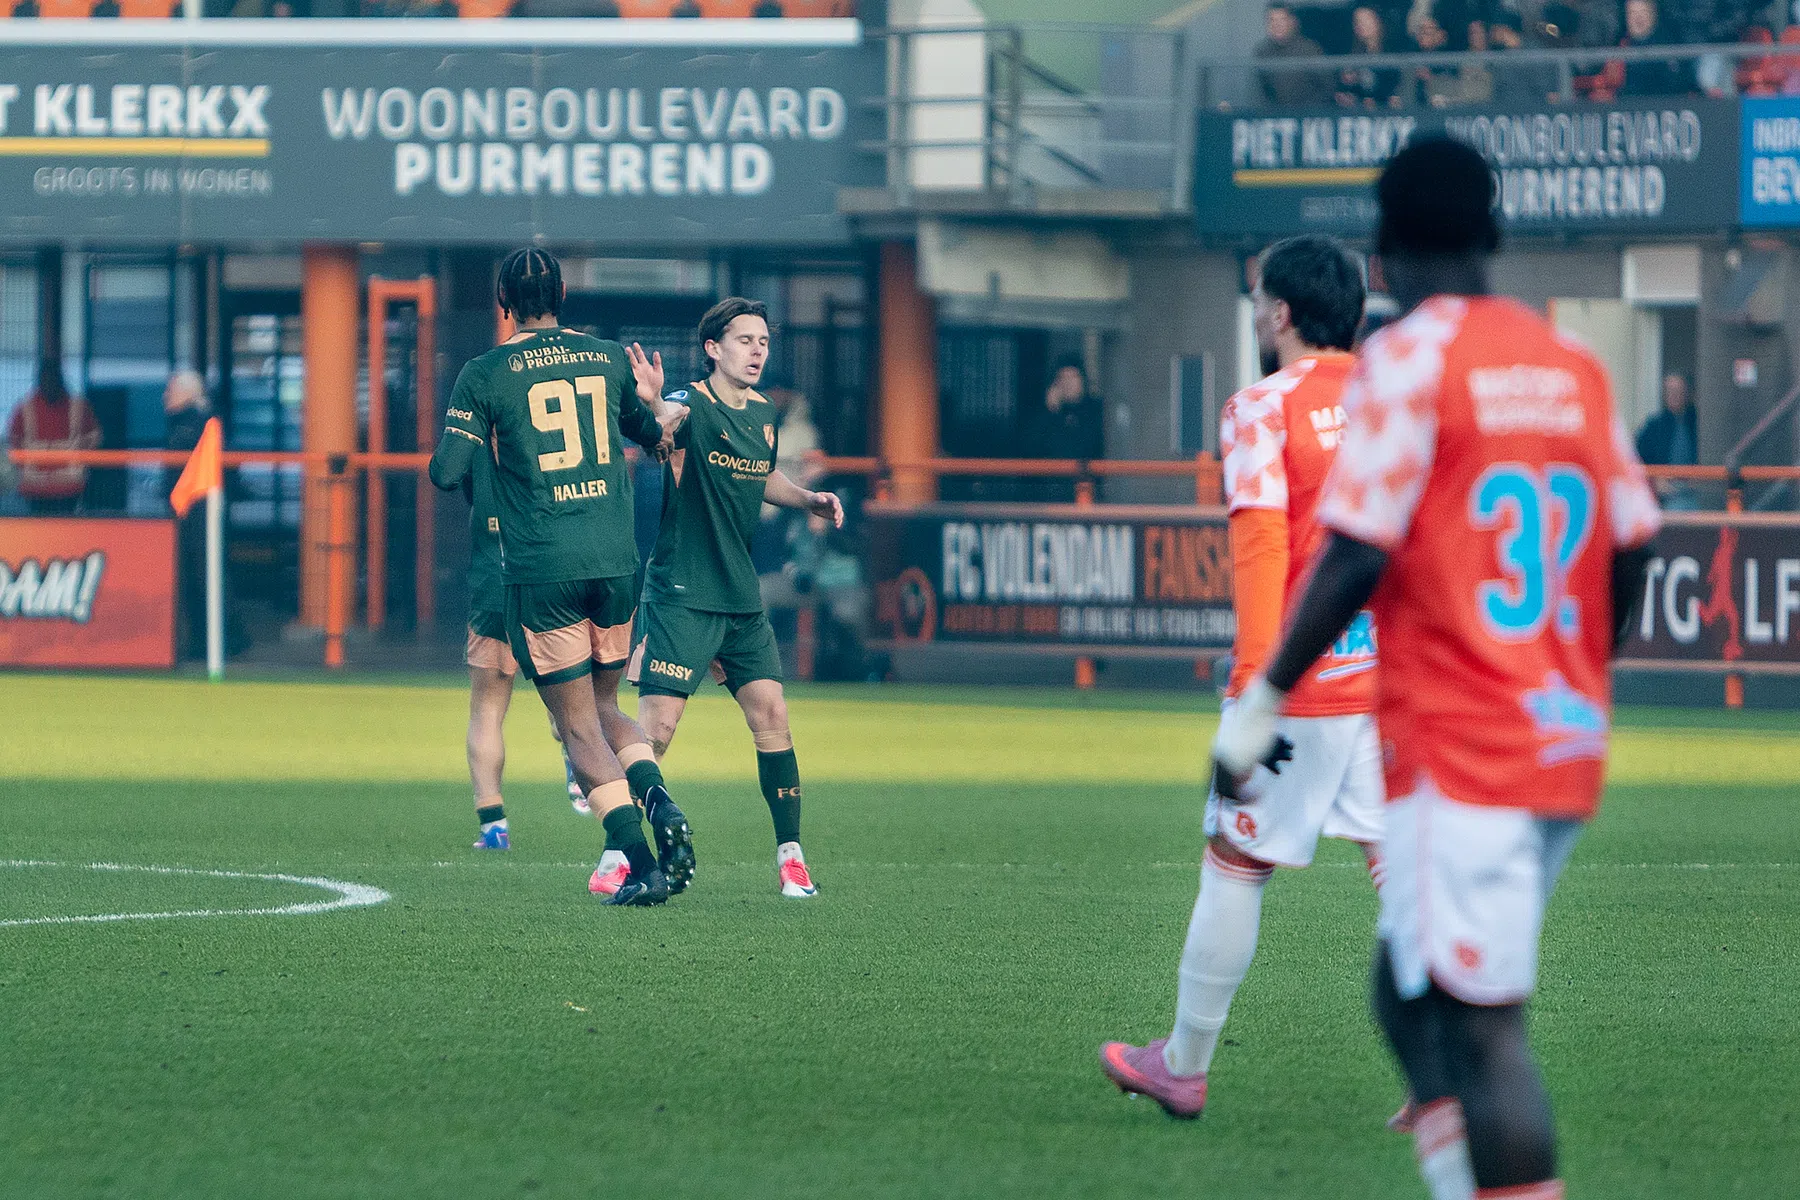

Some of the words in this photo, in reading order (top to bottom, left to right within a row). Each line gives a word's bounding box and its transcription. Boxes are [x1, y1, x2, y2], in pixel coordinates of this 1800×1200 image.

[34, 84, 272, 137] KLERKX
[322, 87, 848, 141] WOONBOULEVARD
[34, 166, 138, 195] GROOTS
[394, 142, 773, 195] PURMEREND
[523, 345, 570, 360] DUBAI-
[526, 351, 611, 369] PROPERTY.NL
[527, 375, 611, 472] 97
[553, 479, 608, 502] HALLER
[943, 522, 981, 600] FC
[983, 522, 1135, 601] VOLENDAM
[650, 658, 693, 681] DASSY
